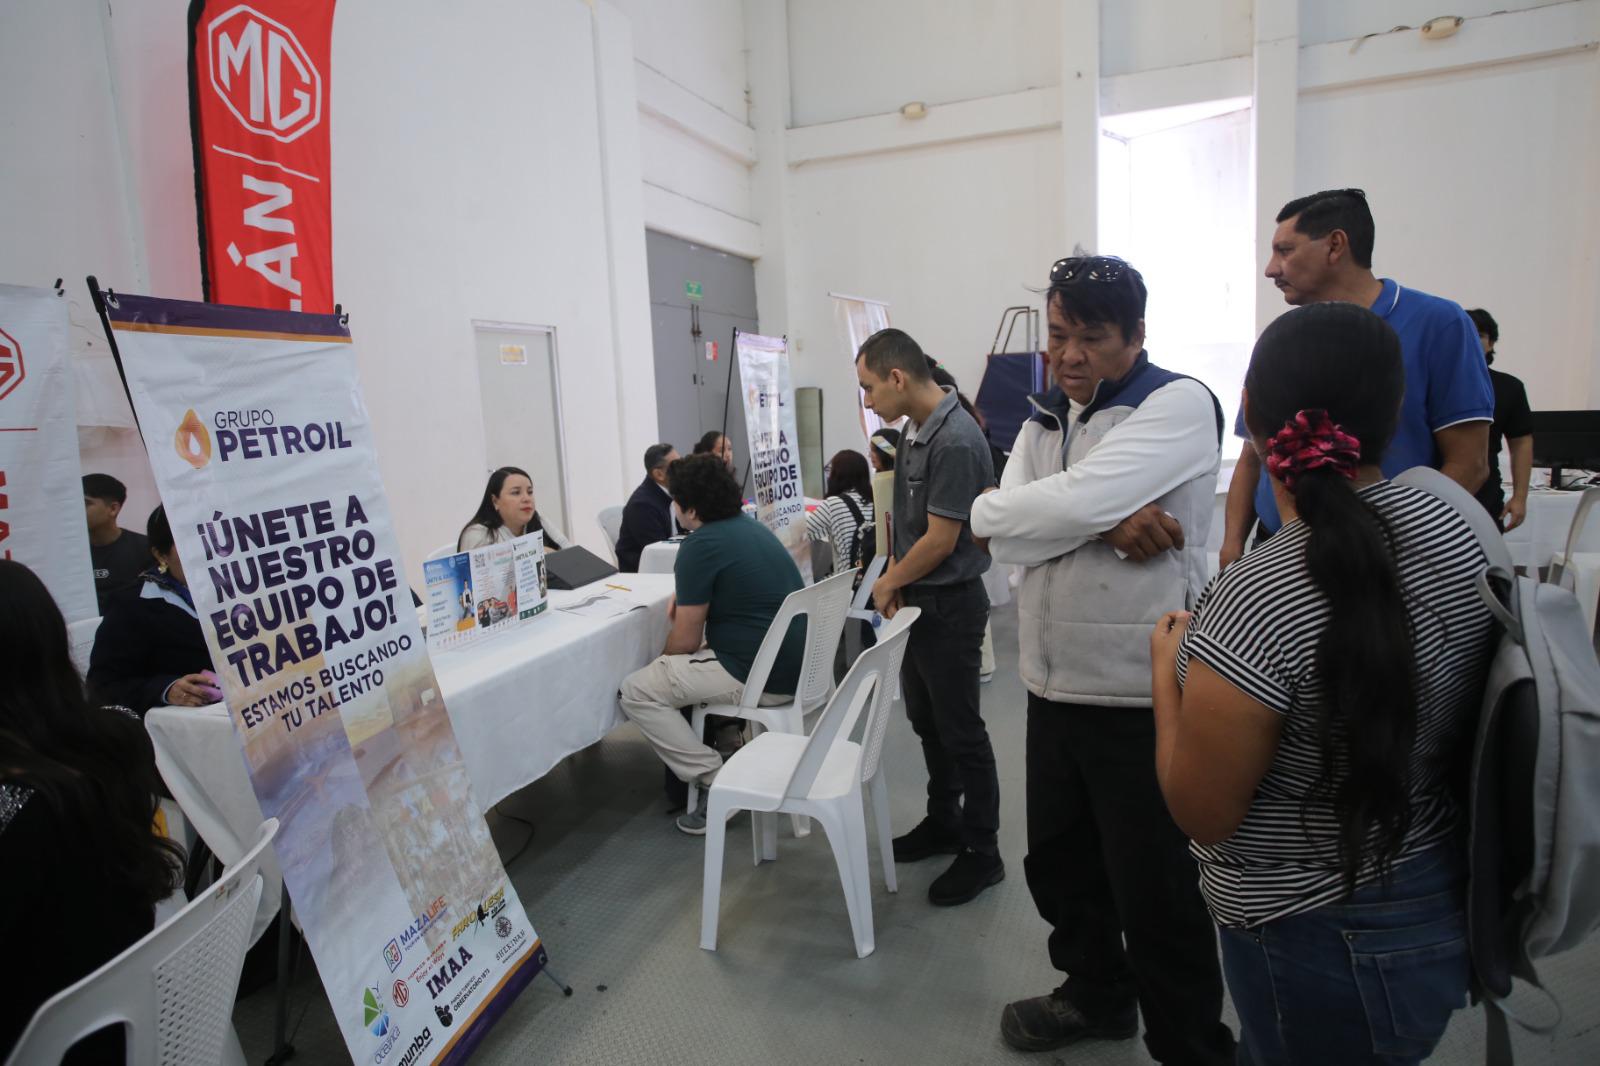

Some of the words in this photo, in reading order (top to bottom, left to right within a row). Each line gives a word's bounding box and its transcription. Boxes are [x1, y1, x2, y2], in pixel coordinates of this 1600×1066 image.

[217, 18, 312, 131] MG
[214, 409, 274, 429] GRUPO
[215, 421, 352, 462] PETROIL
[779, 464, 798, 482] DE
[197, 500, 335, 561] ¡ÚNETE
[345, 494, 368, 528] A
[208, 529, 376, 604] NUESTRO
[210, 576, 344, 650] EQUIPO
[352, 558, 397, 600] DE
[227, 594, 397, 688] TRABAJO!
[241, 676, 316, 729] ESTAMOS
[319, 634, 412, 688] BUSCANDO
[282, 710, 303, 733] TU
[305, 669, 384, 719] TALENTO
[425, 946, 473, 1000] IMAA
